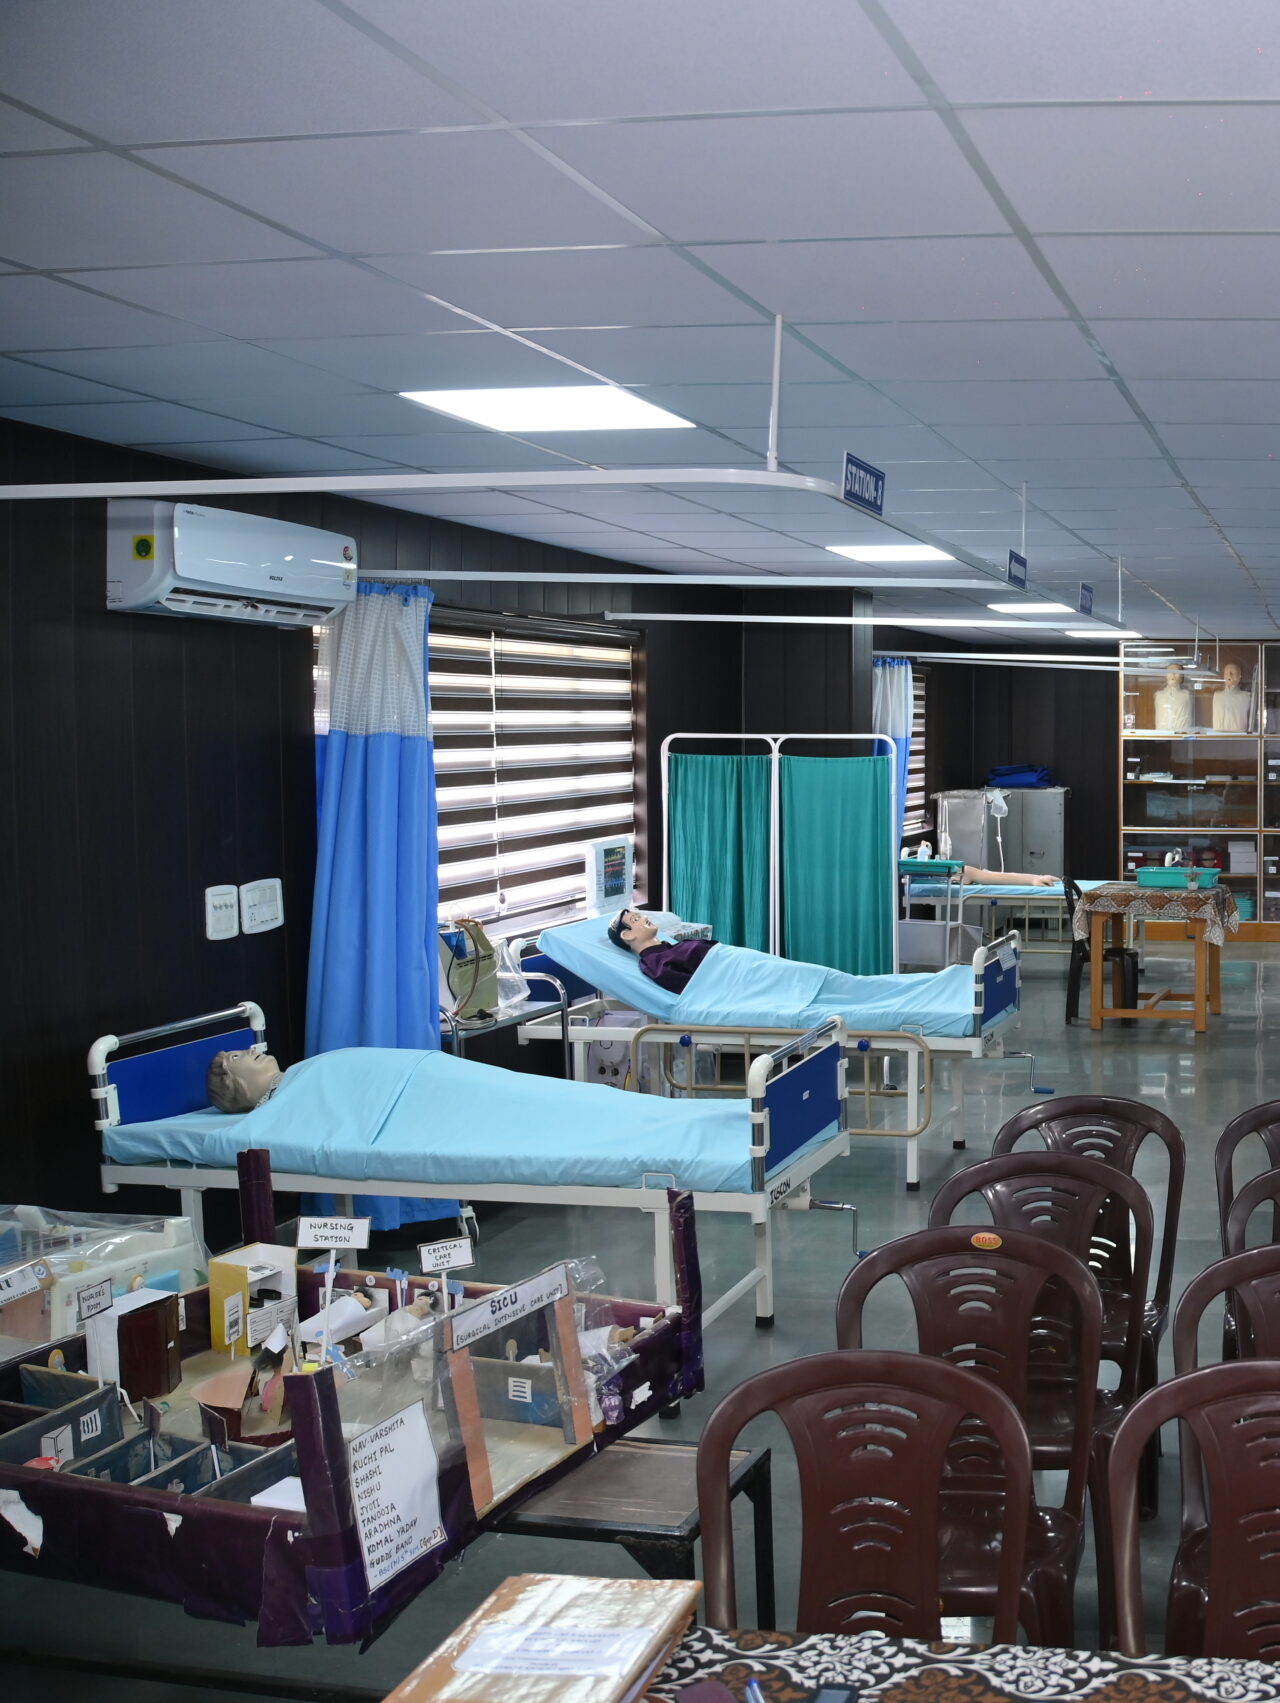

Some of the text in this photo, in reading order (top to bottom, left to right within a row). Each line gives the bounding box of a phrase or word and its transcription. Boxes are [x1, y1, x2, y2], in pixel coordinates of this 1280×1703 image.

[877, 480, 883, 506] 8
[309, 1222, 354, 1232] NURSING
[313, 1234, 350, 1244] STATION
[975, 1235, 997, 1244] BOSS
[427, 1244, 463, 1256] CRITICAL
[434, 1252, 452, 1261] CARE
[432, 1260, 452, 1269] UNIT
[87, 1301, 101, 1313] ROOM
[490, 1291, 518, 1315] SICU
[494, 1305, 526, 1327] INTENSIVE
[530, 1294, 544, 1307] CARE
[353, 1443, 395, 1473] RUCHI PAL
[354, 1465, 382, 1489] SHASHI
[357, 1481, 381, 1502] NISHU
[360, 1498, 381, 1516] JYOTI
[364, 1514, 402, 1541] ARADHNA
[367, 1534, 394, 1556] KOMAL
[395, 1536, 413, 1554] BANO
